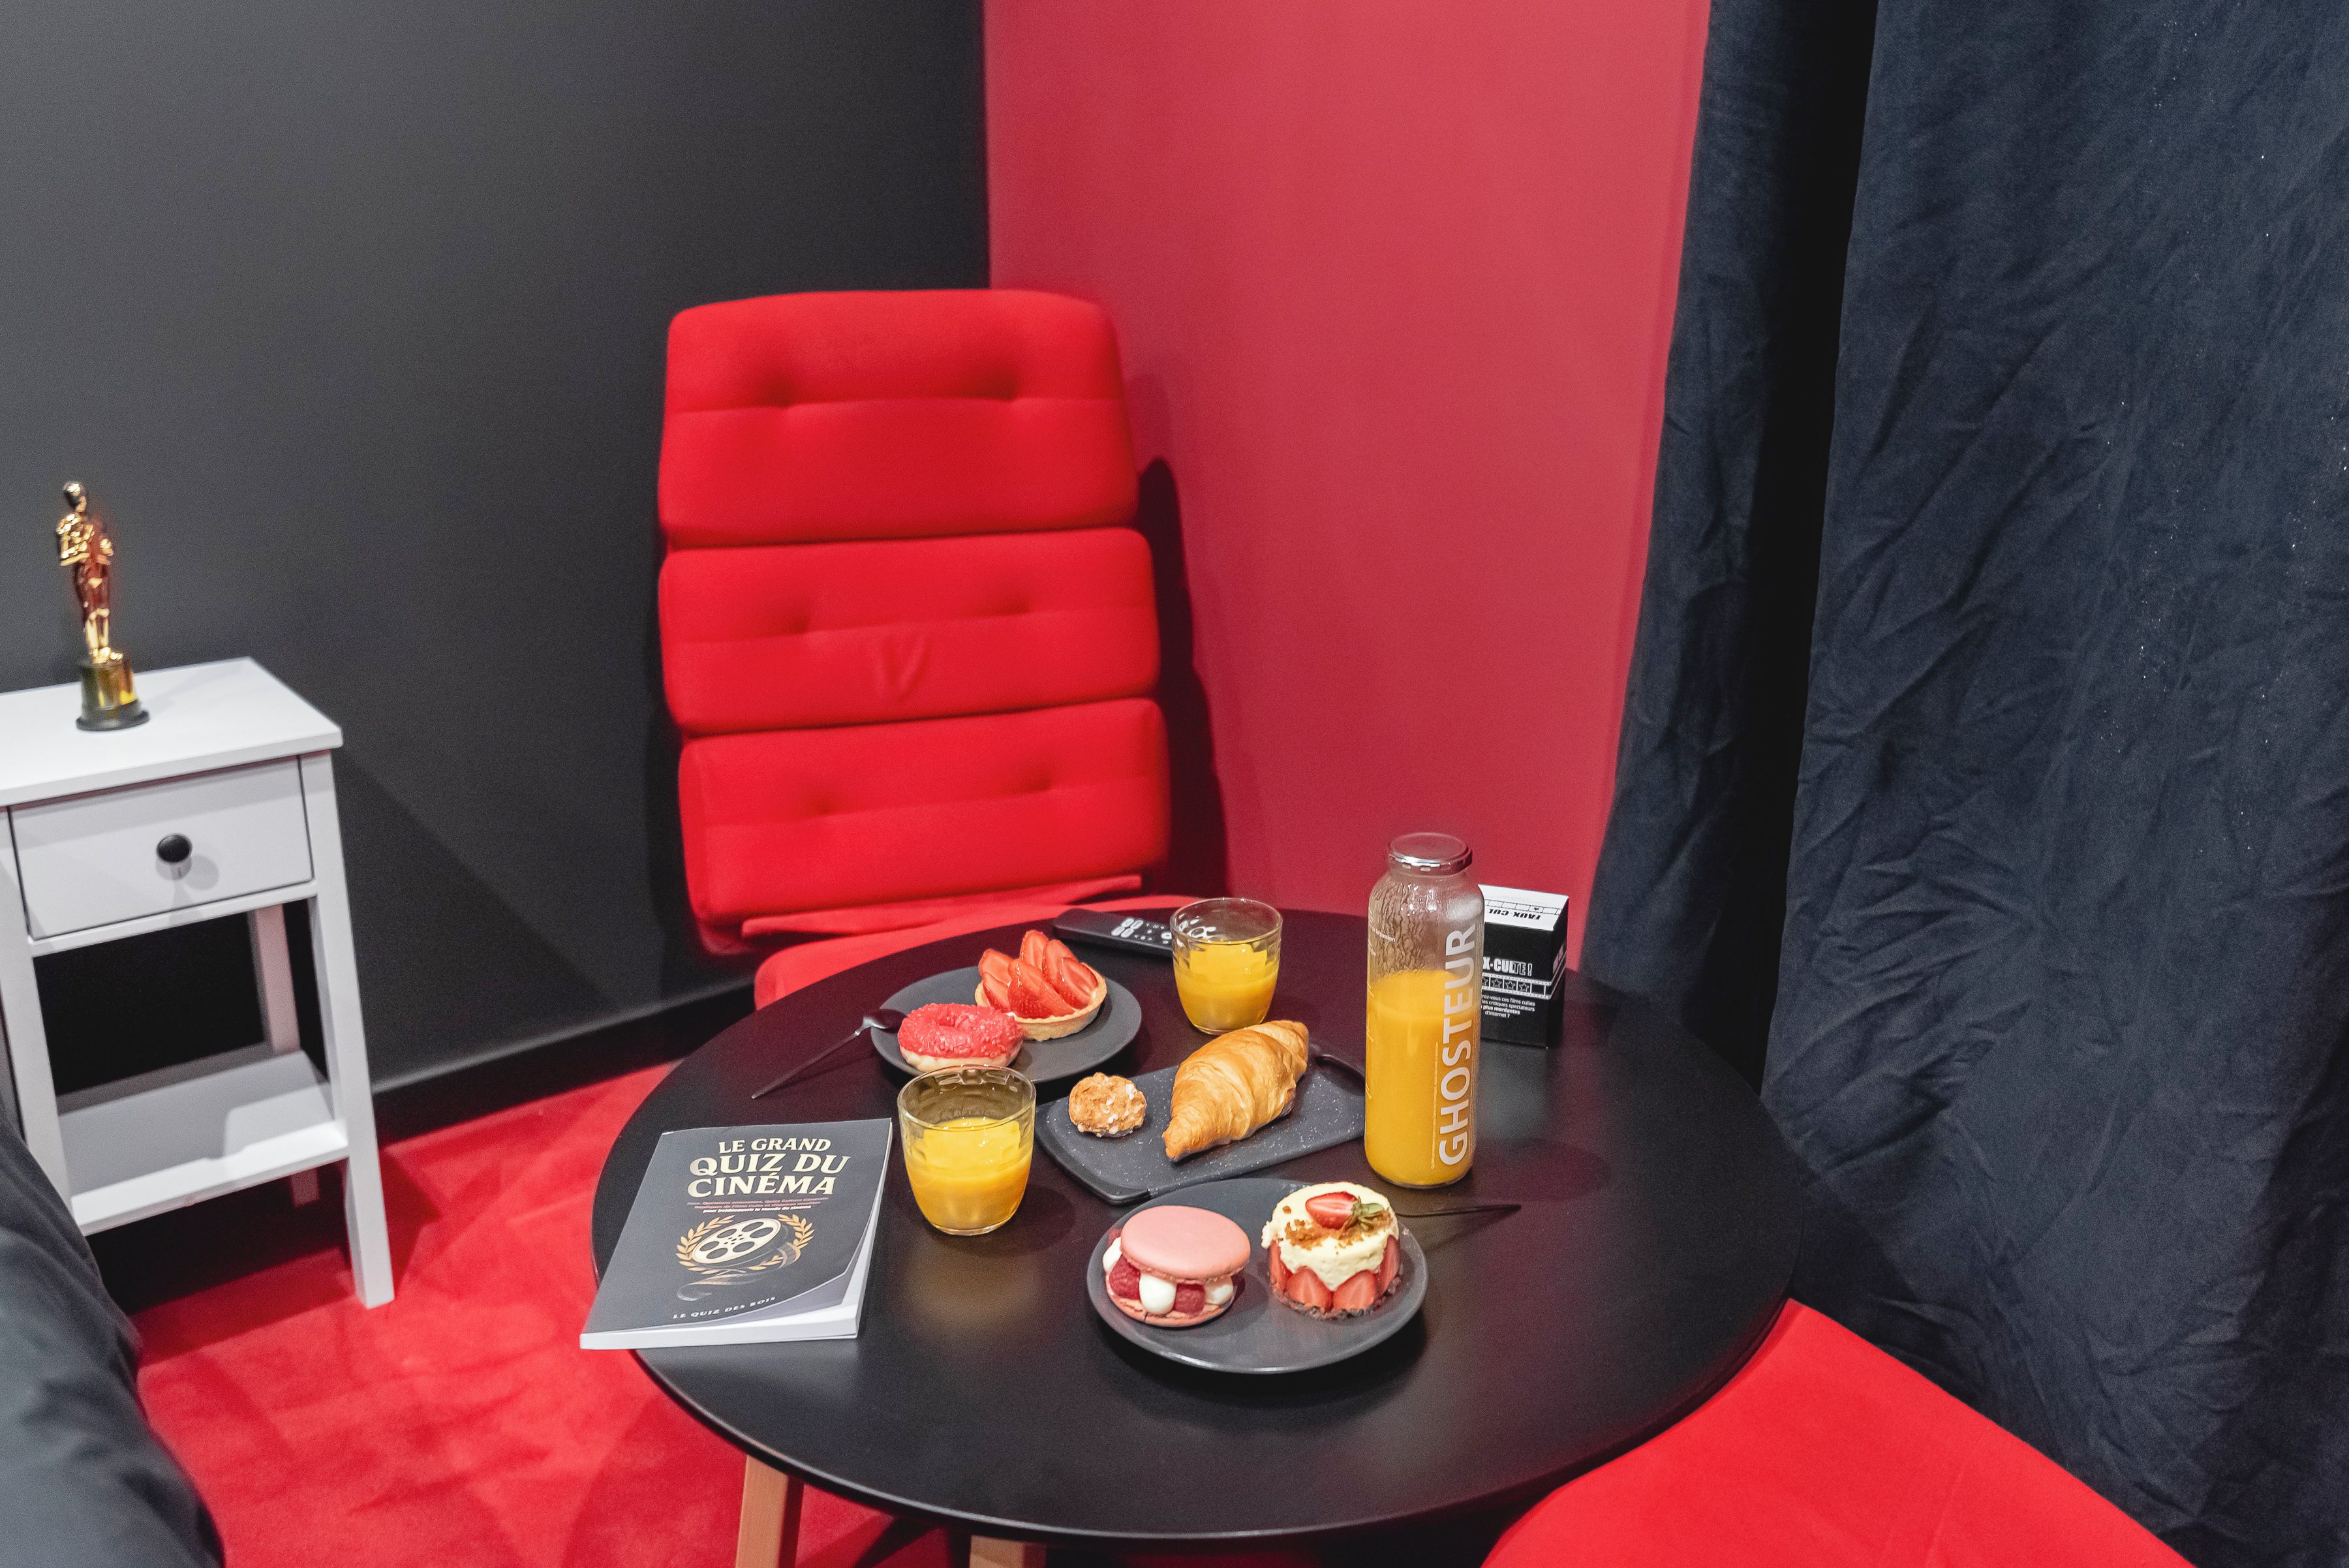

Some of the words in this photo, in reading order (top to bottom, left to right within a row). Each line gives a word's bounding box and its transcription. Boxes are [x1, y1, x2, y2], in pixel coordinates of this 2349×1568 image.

[1482, 957, 1526, 976] X-CULTE
[1494, 1007, 1520, 1015] mordantes
[1509, 1004, 1535, 1012] spectateurs
[1439, 923, 1475, 1165] GHOSTEUR
[718, 1139, 746, 1154] LE
[750, 1137, 831, 1152] GRAND
[689, 1153, 787, 1176] QUIZ
[792, 1153, 852, 1175] DU
[687, 1172, 837, 1198] CINÉMA
[690, 1309, 721, 1317] QUIZ
[724, 1304, 745, 1313] DES
